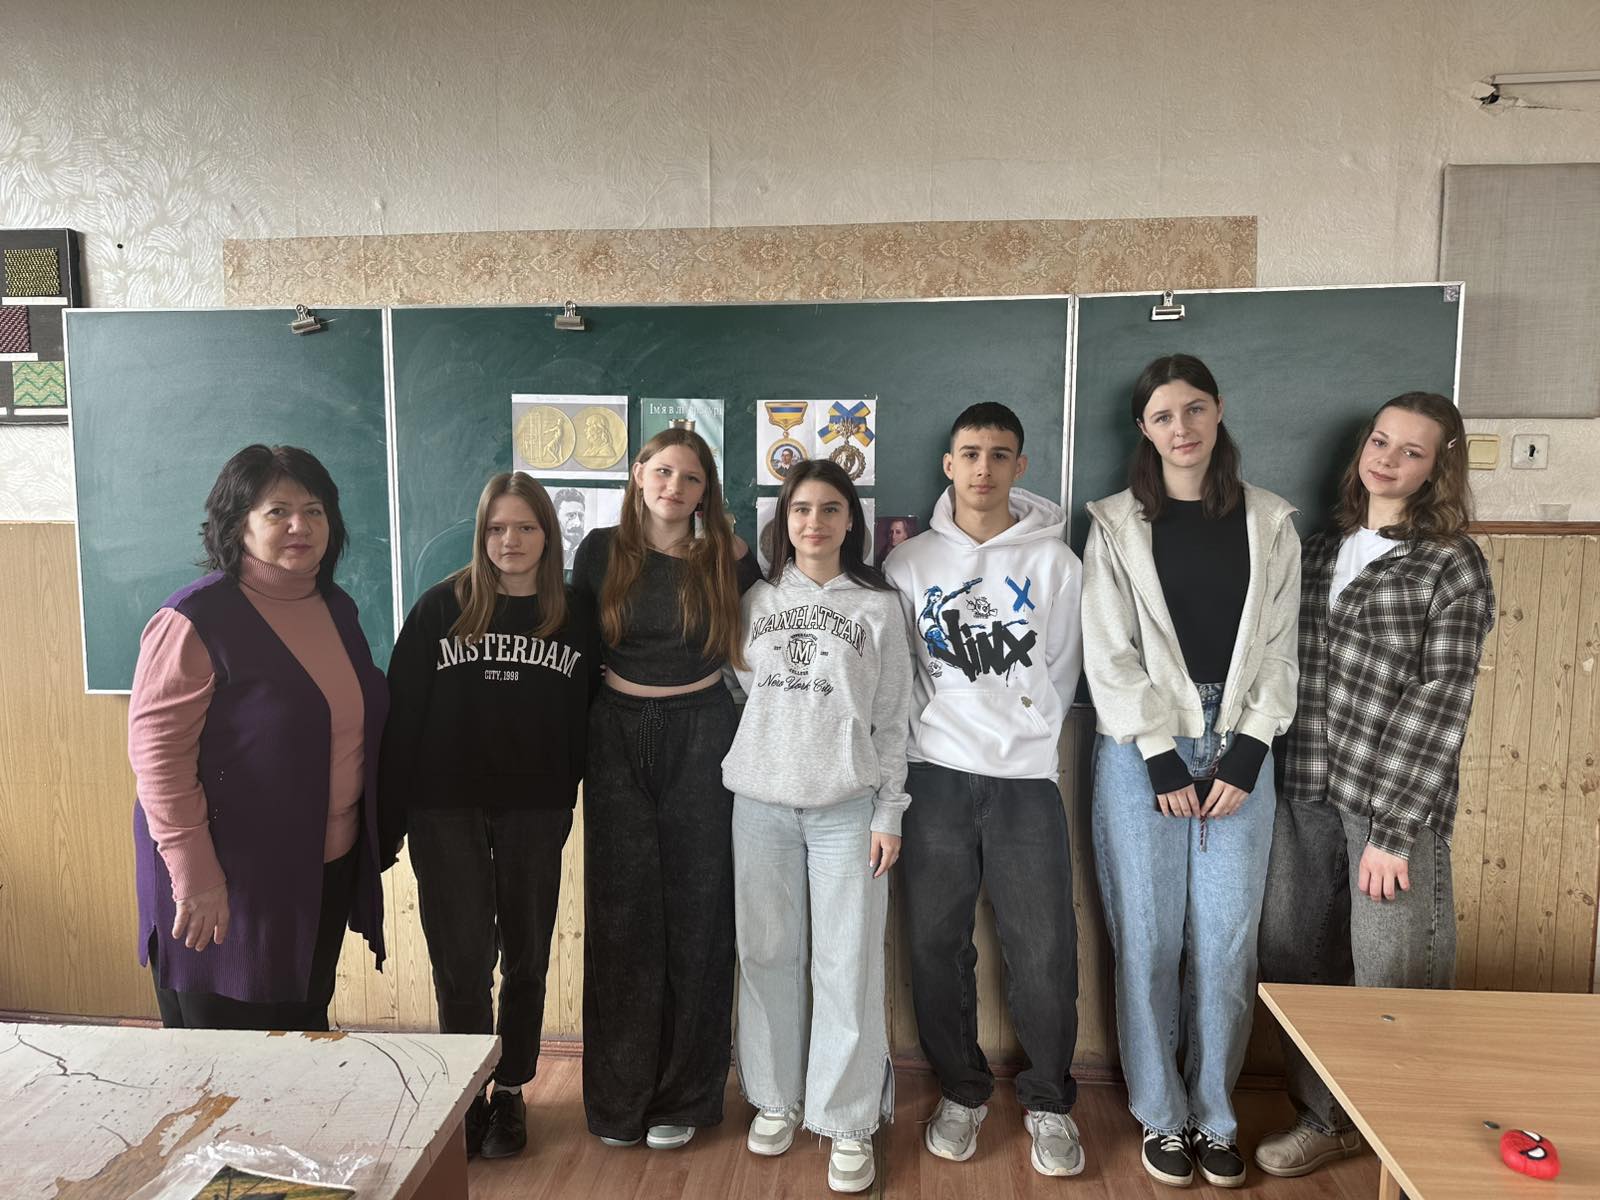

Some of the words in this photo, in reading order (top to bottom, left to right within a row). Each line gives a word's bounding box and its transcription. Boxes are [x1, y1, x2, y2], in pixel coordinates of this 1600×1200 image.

[748, 605, 867, 657] MANHATTAN
[503, 671, 519, 681] 1998
[758, 673, 784, 688] New
[784, 675, 811, 692] York
[813, 678, 834, 697] City
